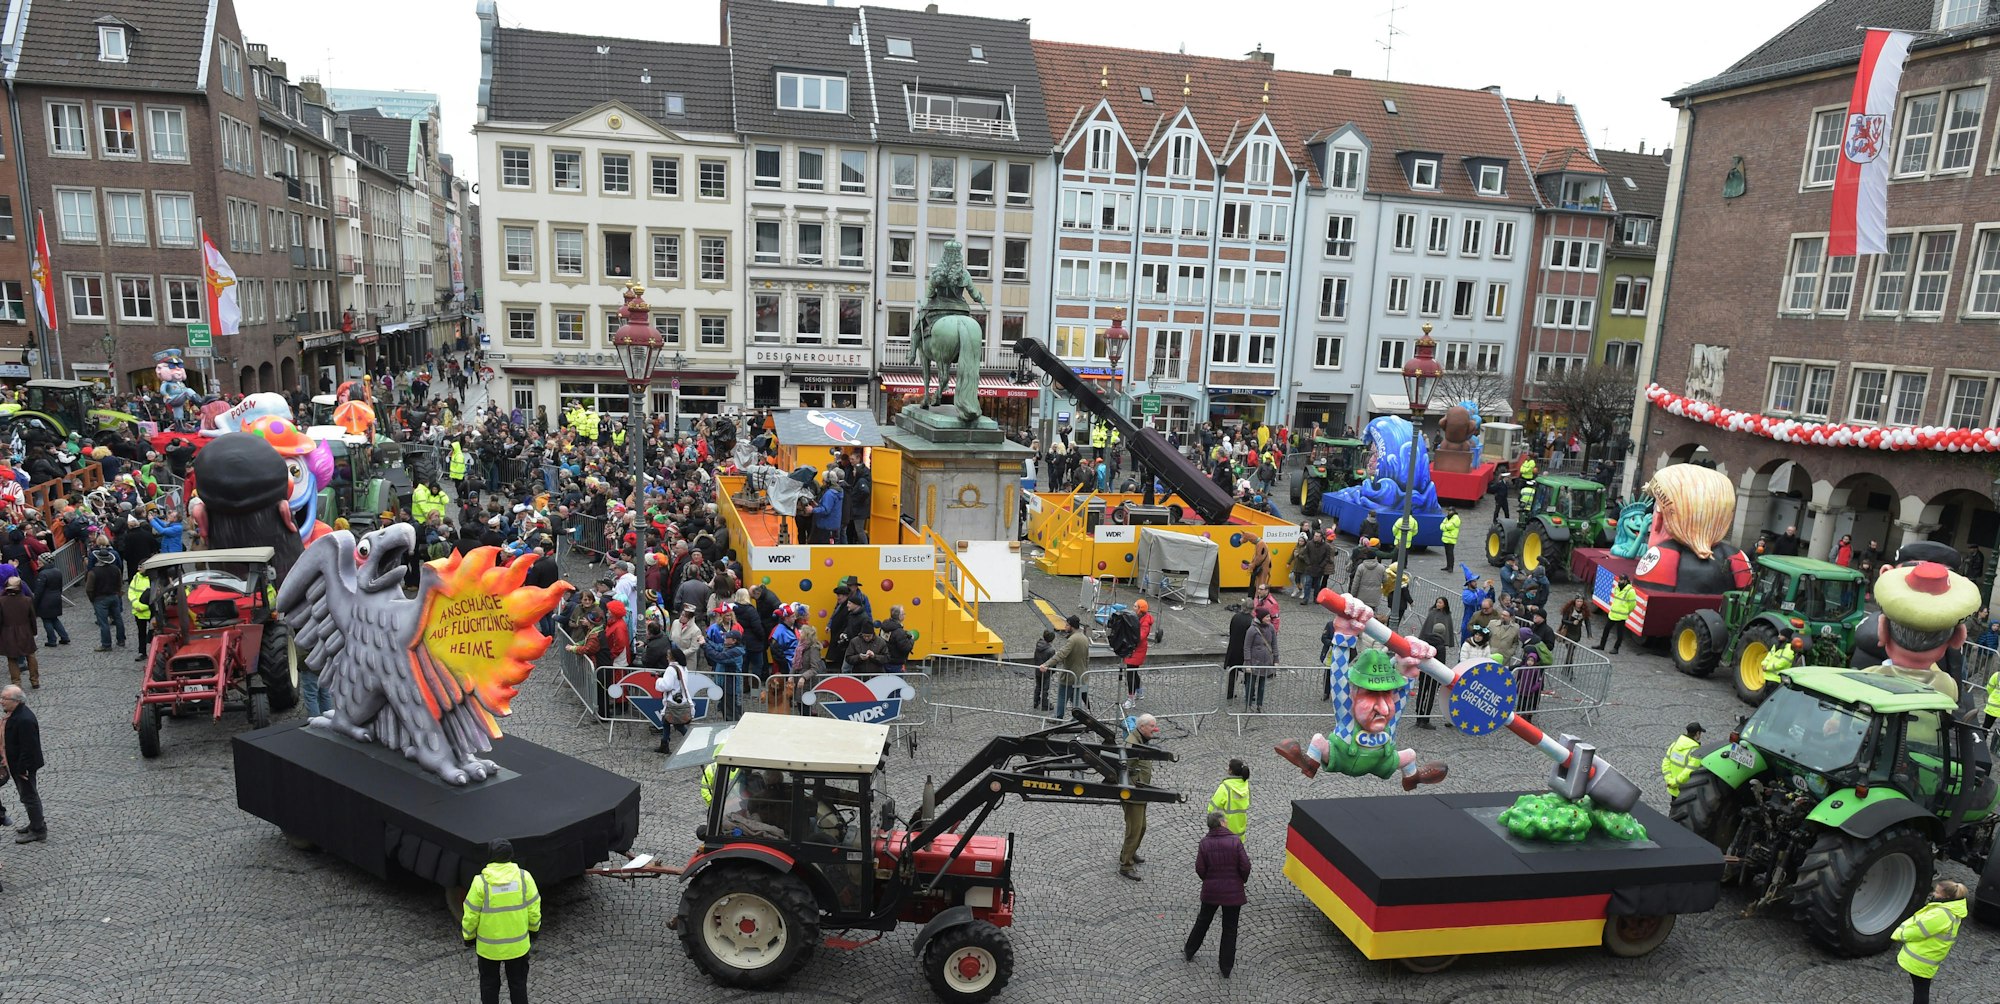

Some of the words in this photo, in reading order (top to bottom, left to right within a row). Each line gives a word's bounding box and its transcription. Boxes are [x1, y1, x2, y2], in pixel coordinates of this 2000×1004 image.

[230, 400, 257, 420] POLEN
[1266, 530, 1278, 538] Das
[1278, 530, 1295, 538] Erste
[768, 555, 791, 563] WDR
[885, 555, 902, 563] Das
[903, 555, 926, 563] Erste
[440, 593, 503, 624] ANSCHLÄGE
[429, 625, 449, 640] AUF
[450, 640, 495, 659] HEIME
[1368, 675, 1397, 685] HOFER
[1469, 680, 1503, 707] OFFENE
[1460, 689, 1499, 718] GRENZEN
[847, 705, 885, 723] WDR
[1358, 732, 1387, 746] CSU
[1022, 779, 1062, 792] STOLL
